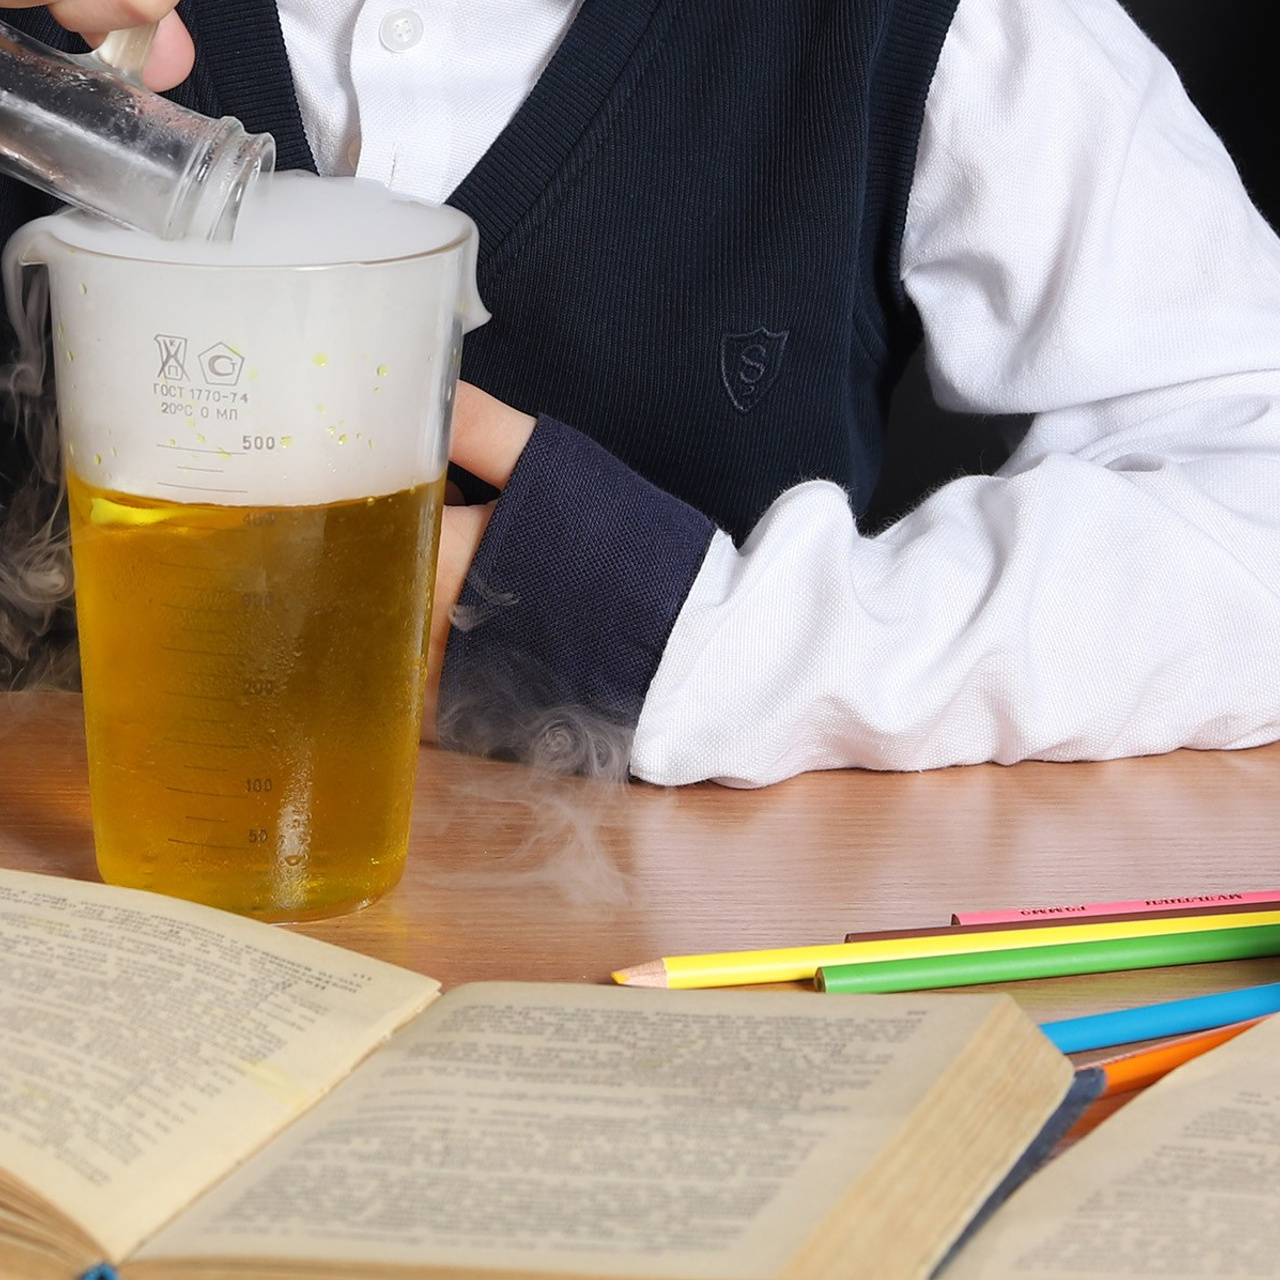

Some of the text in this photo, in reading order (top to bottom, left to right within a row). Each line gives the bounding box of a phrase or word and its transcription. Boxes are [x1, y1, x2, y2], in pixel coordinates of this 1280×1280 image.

[153, 383, 248, 404] ГОСТ 1770-74
[242, 435, 276, 451] 500
[245, 778, 273, 793] 100
[248, 829, 268, 843] 50
